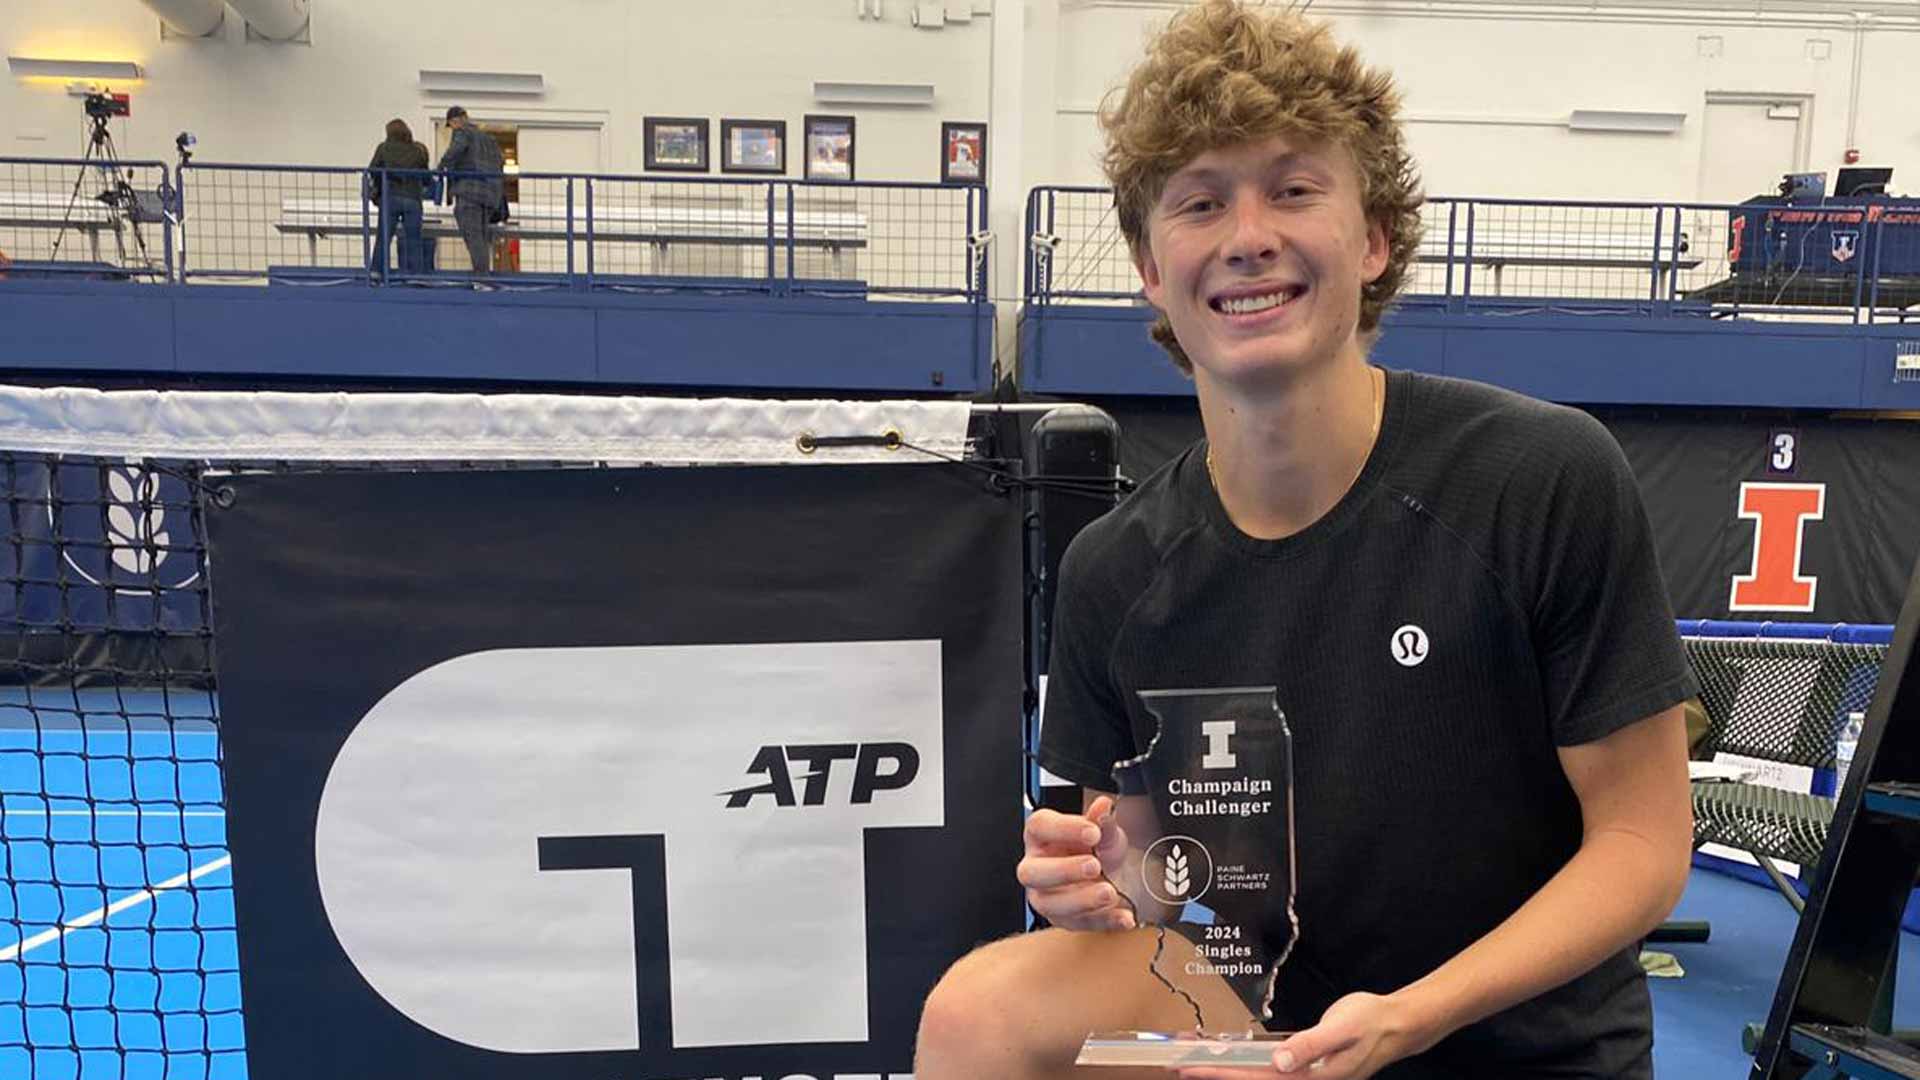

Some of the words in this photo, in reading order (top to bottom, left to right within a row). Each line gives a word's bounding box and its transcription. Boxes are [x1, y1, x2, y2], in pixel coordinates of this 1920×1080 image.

[1772, 434, 1795, 470] 3
[1729, 482, 1826, 612] I
[1202, 720, 1236, 769] I
[714, 742, 920, 808] ATP
[1168, 777, 1272, 795] Champaign
[1169, 799, 1272, 817] Challenger
[1216, 865, 1245, 873] PAINE
[1216, 873, 1270, 882] SCHWARTZ
[1216, 882, 1268, 890] PARTNERS
[1205, 926, 1241, 940] 2024
[1195, 944, 1252, 959] Singles
[1185, 962, 1263, 977] Champion
